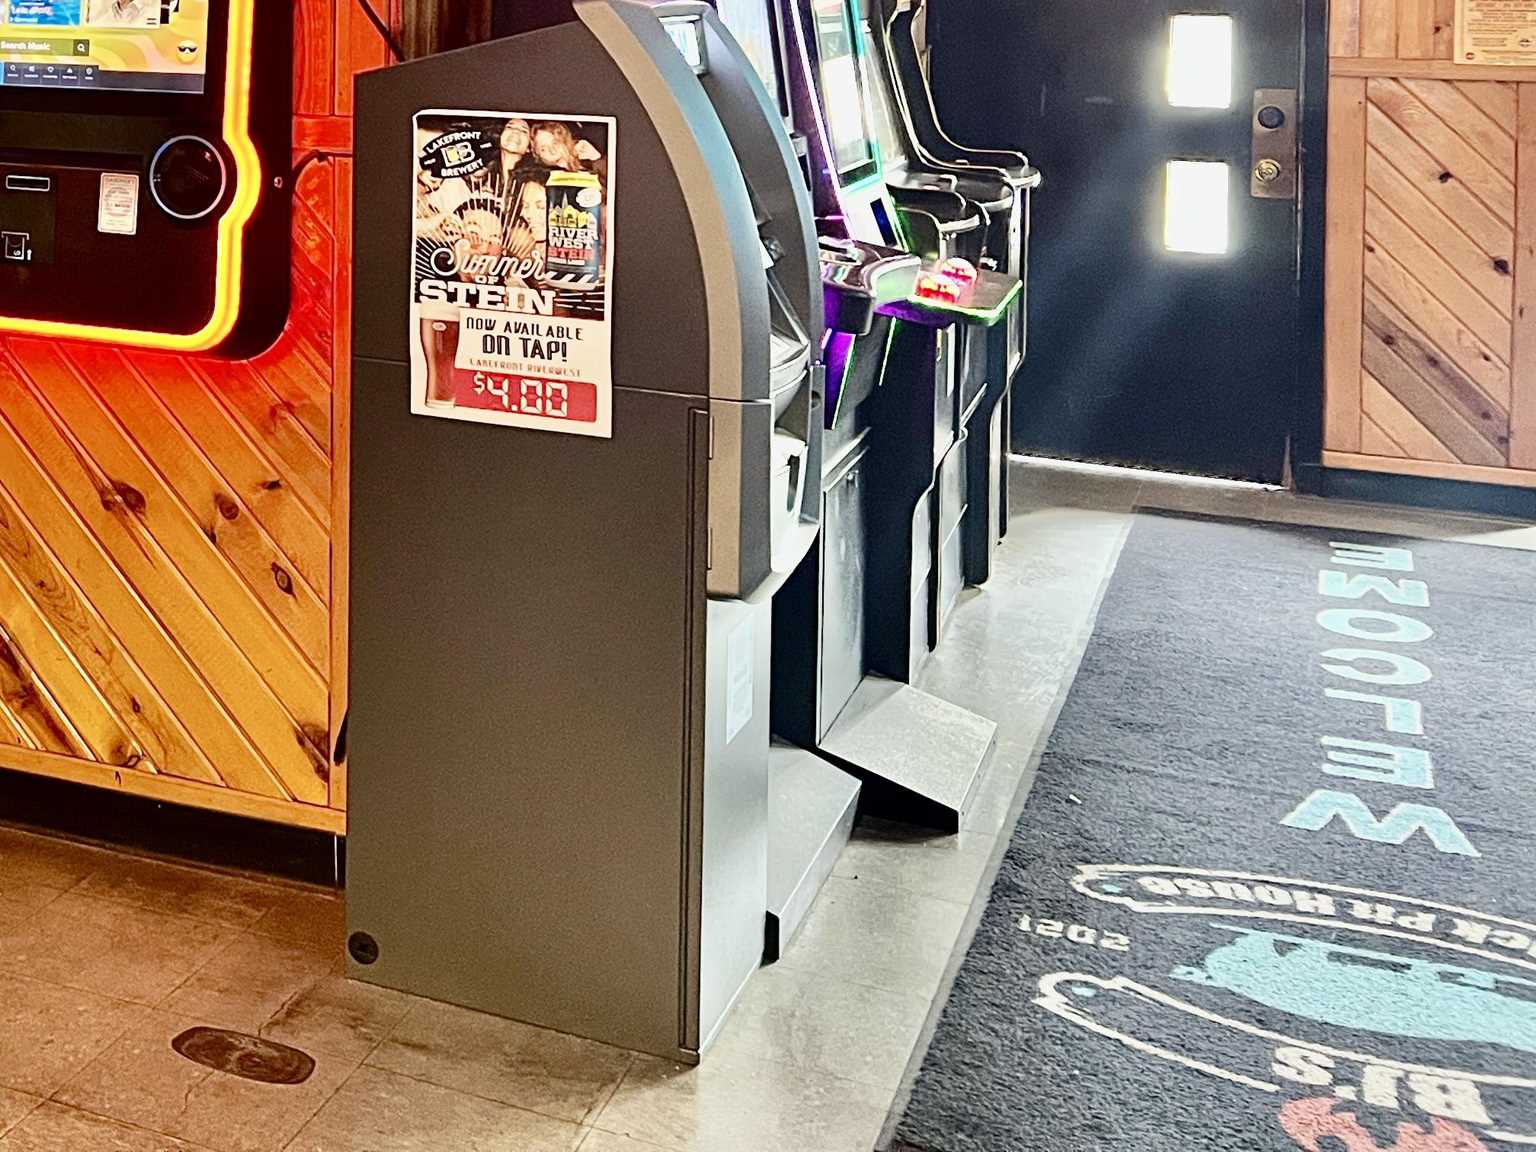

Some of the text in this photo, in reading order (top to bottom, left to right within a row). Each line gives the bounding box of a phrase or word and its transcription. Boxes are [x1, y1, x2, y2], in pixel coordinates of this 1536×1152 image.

[426, 131, 482, 153] LAKEFRONT
[440, 158, 484, 177] BREWERY
[548, 237, 594, 249] WEST
[549, 226, 599, 241] RIVER
[430, 238, 548, 280] Summer
[474, 275, 499, 285] OF
[419, 279, 556, 315] STEIN
[466, 317, 584, 341] NOW AVAILABLE
[482, 334, 567, 362] ON TAP!
[473, 370, 568, 417] $4.00
[1280, 541, 1482, 857] WELCOME
